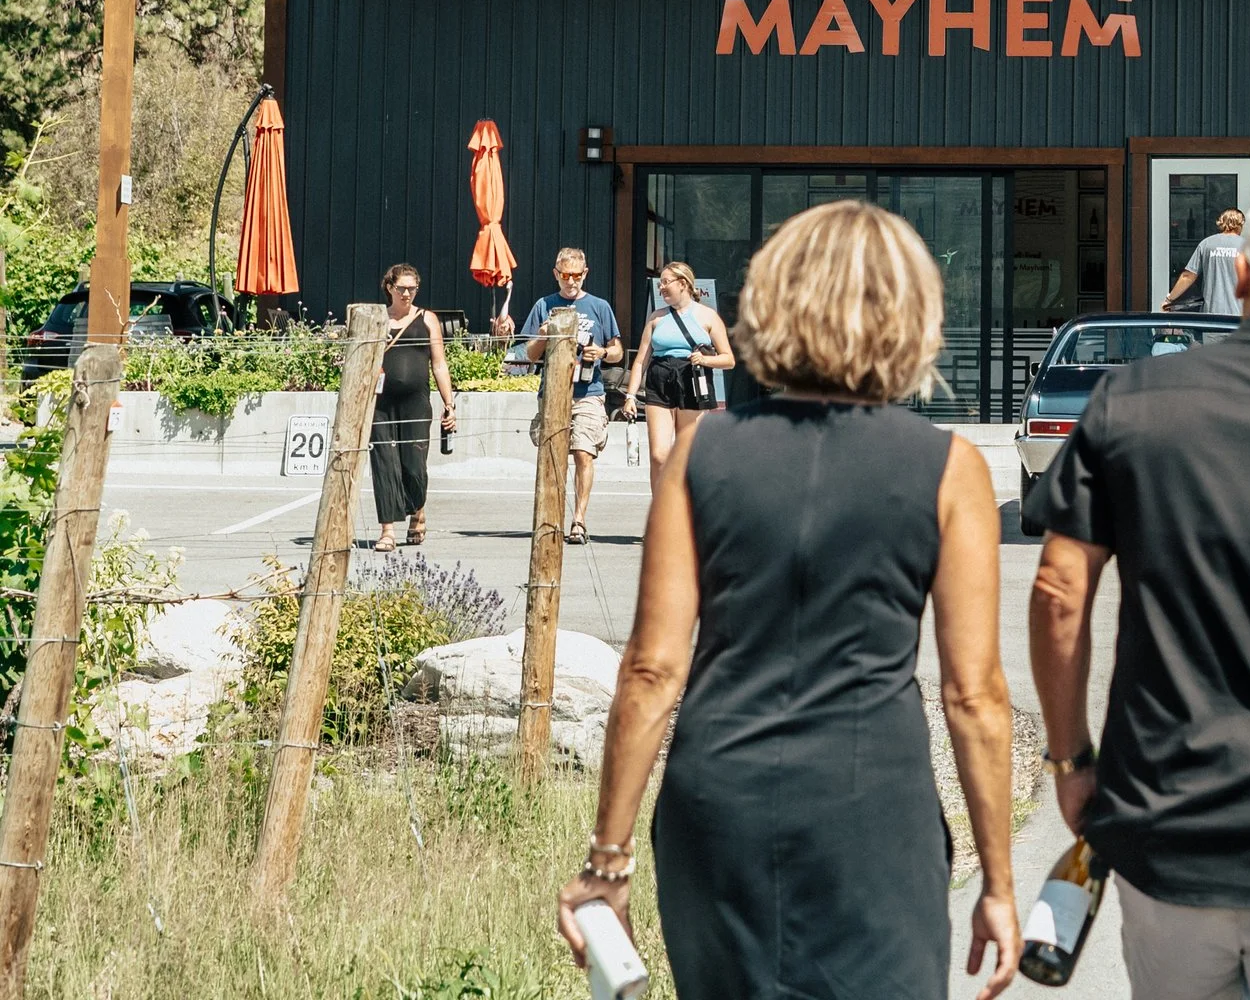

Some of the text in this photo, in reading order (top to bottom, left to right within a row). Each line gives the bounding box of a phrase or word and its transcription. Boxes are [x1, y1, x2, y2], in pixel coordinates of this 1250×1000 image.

[1209, 250, 1240, 258] MAYHE
[290, 432, 324, 458] 20
[293, 463, 319, 471] kmh
